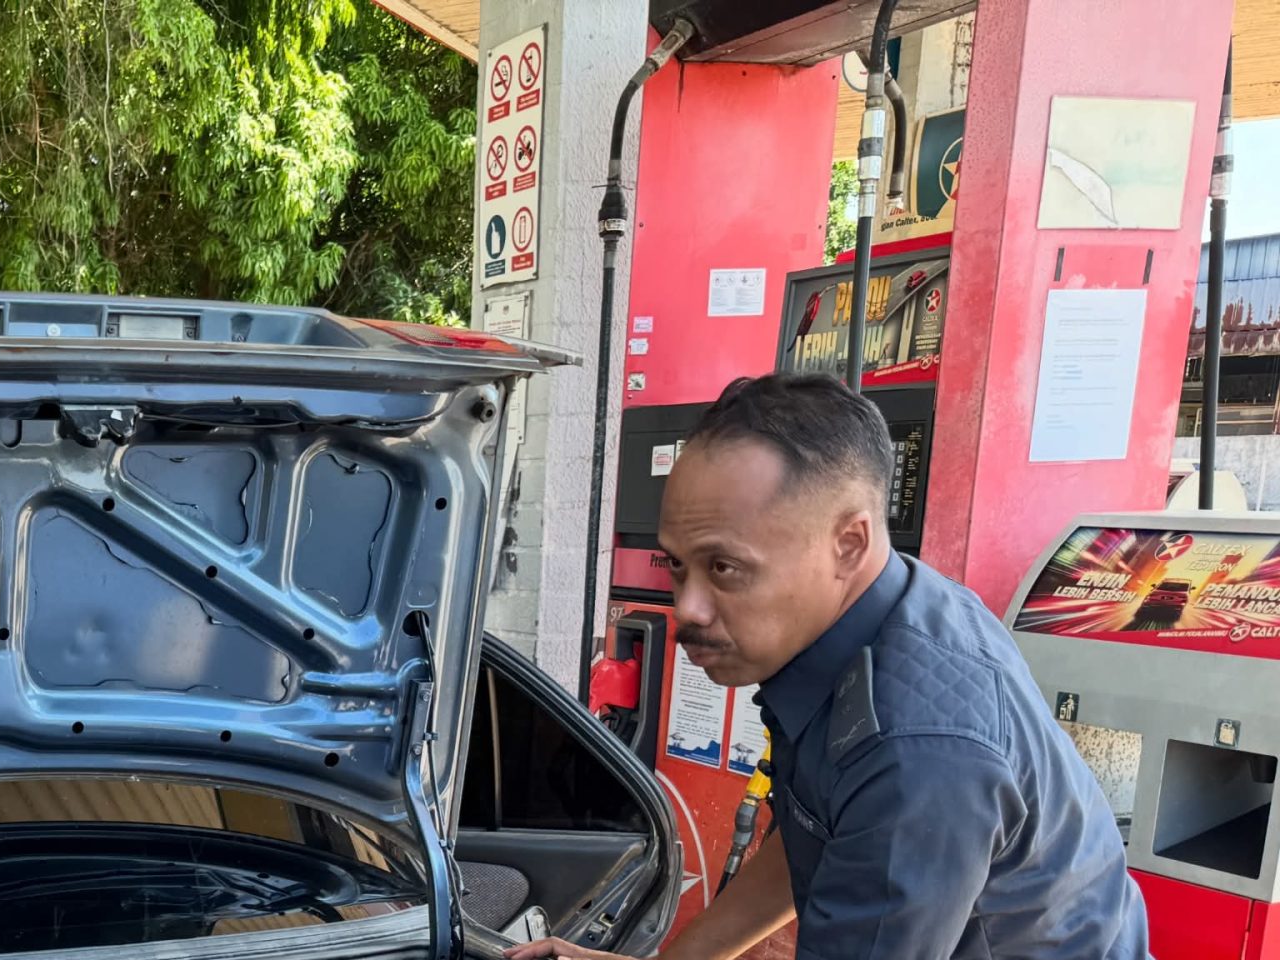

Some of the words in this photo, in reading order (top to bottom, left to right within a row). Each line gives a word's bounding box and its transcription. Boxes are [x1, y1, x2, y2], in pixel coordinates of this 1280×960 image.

[1076, 571, 1132, 588] ENJIN
[1052, 586, 1090, 599] LEBIH
[1088, 588, 1138, 603] BERSIH
[1194, 596, 1238, 611] LEBIH
[610, 607, 625, 622] 97
